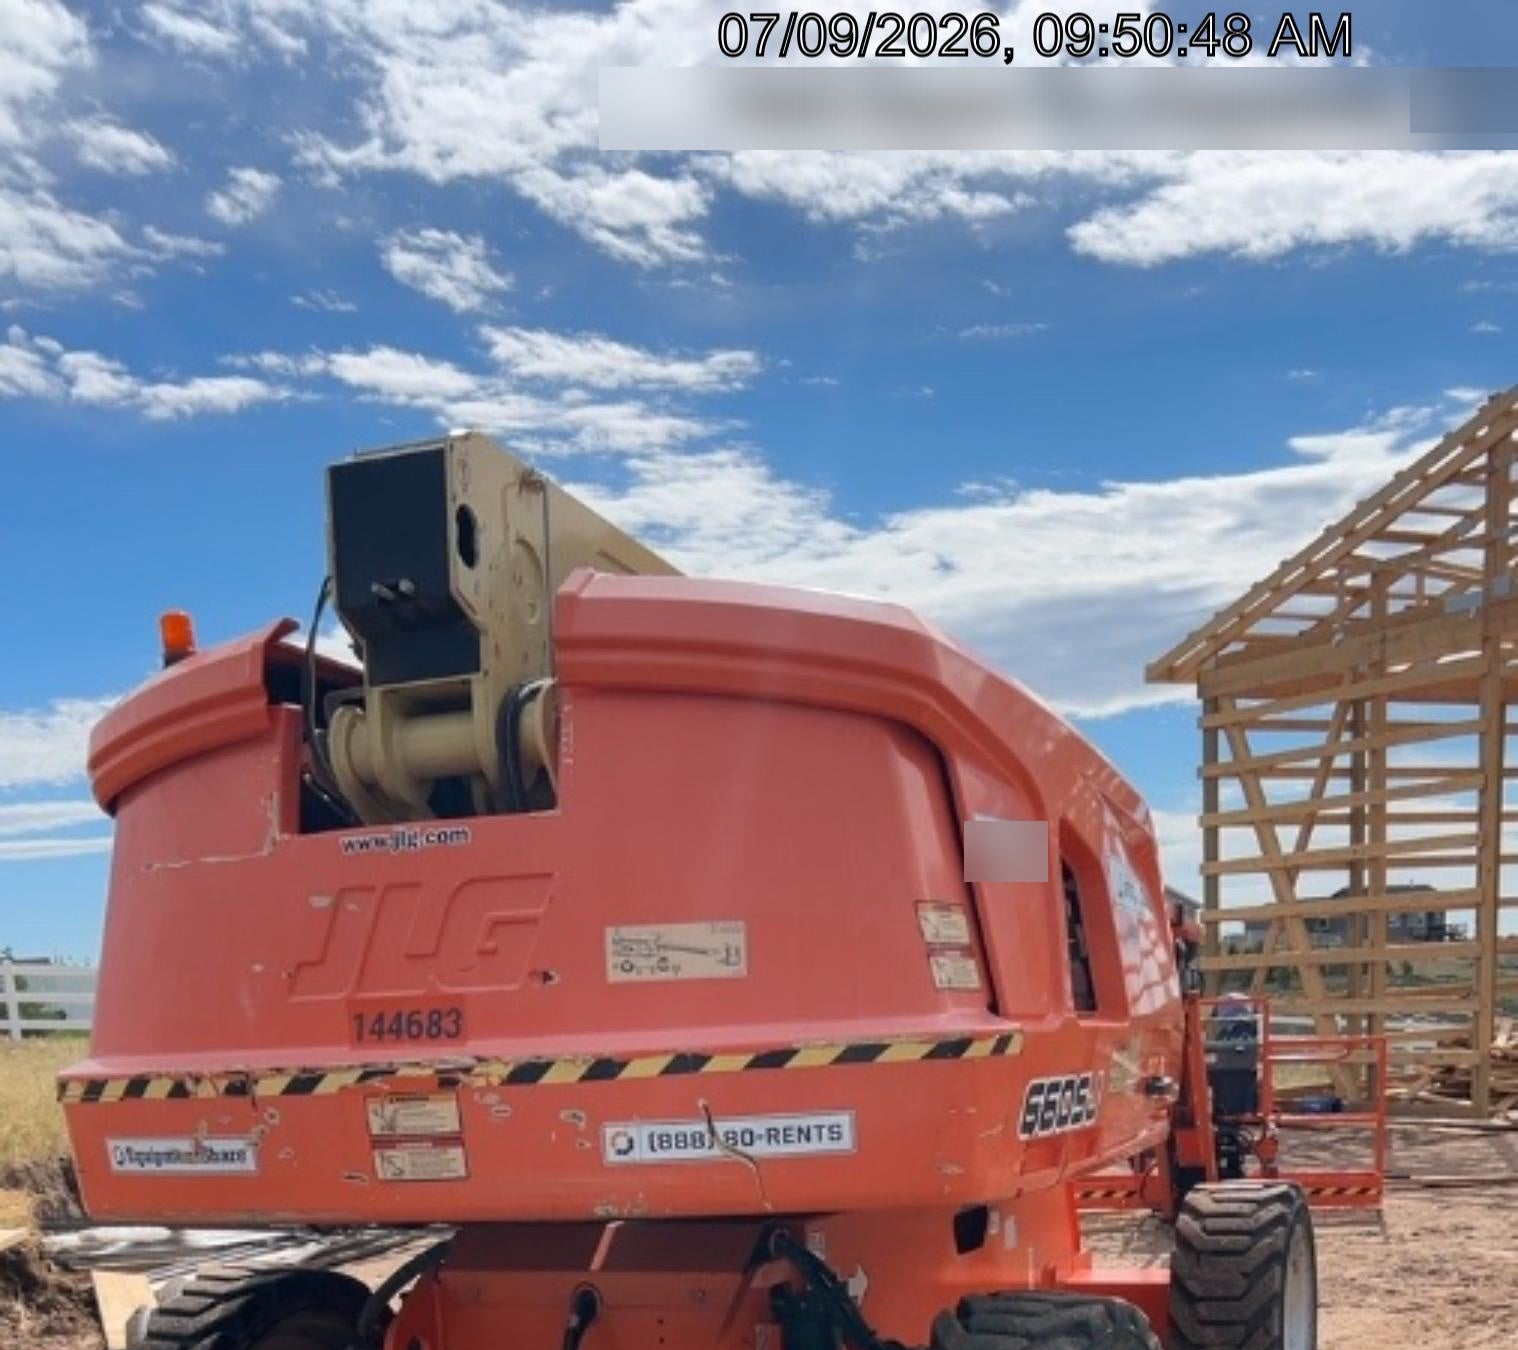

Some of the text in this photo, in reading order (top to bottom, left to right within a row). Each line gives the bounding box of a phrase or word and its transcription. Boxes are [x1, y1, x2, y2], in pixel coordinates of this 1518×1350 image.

[341, 828, 469, 853] www.jlg.com
[288, 872, 556, 1001] JLG
[352, 1007, 463, 1042] 144683
